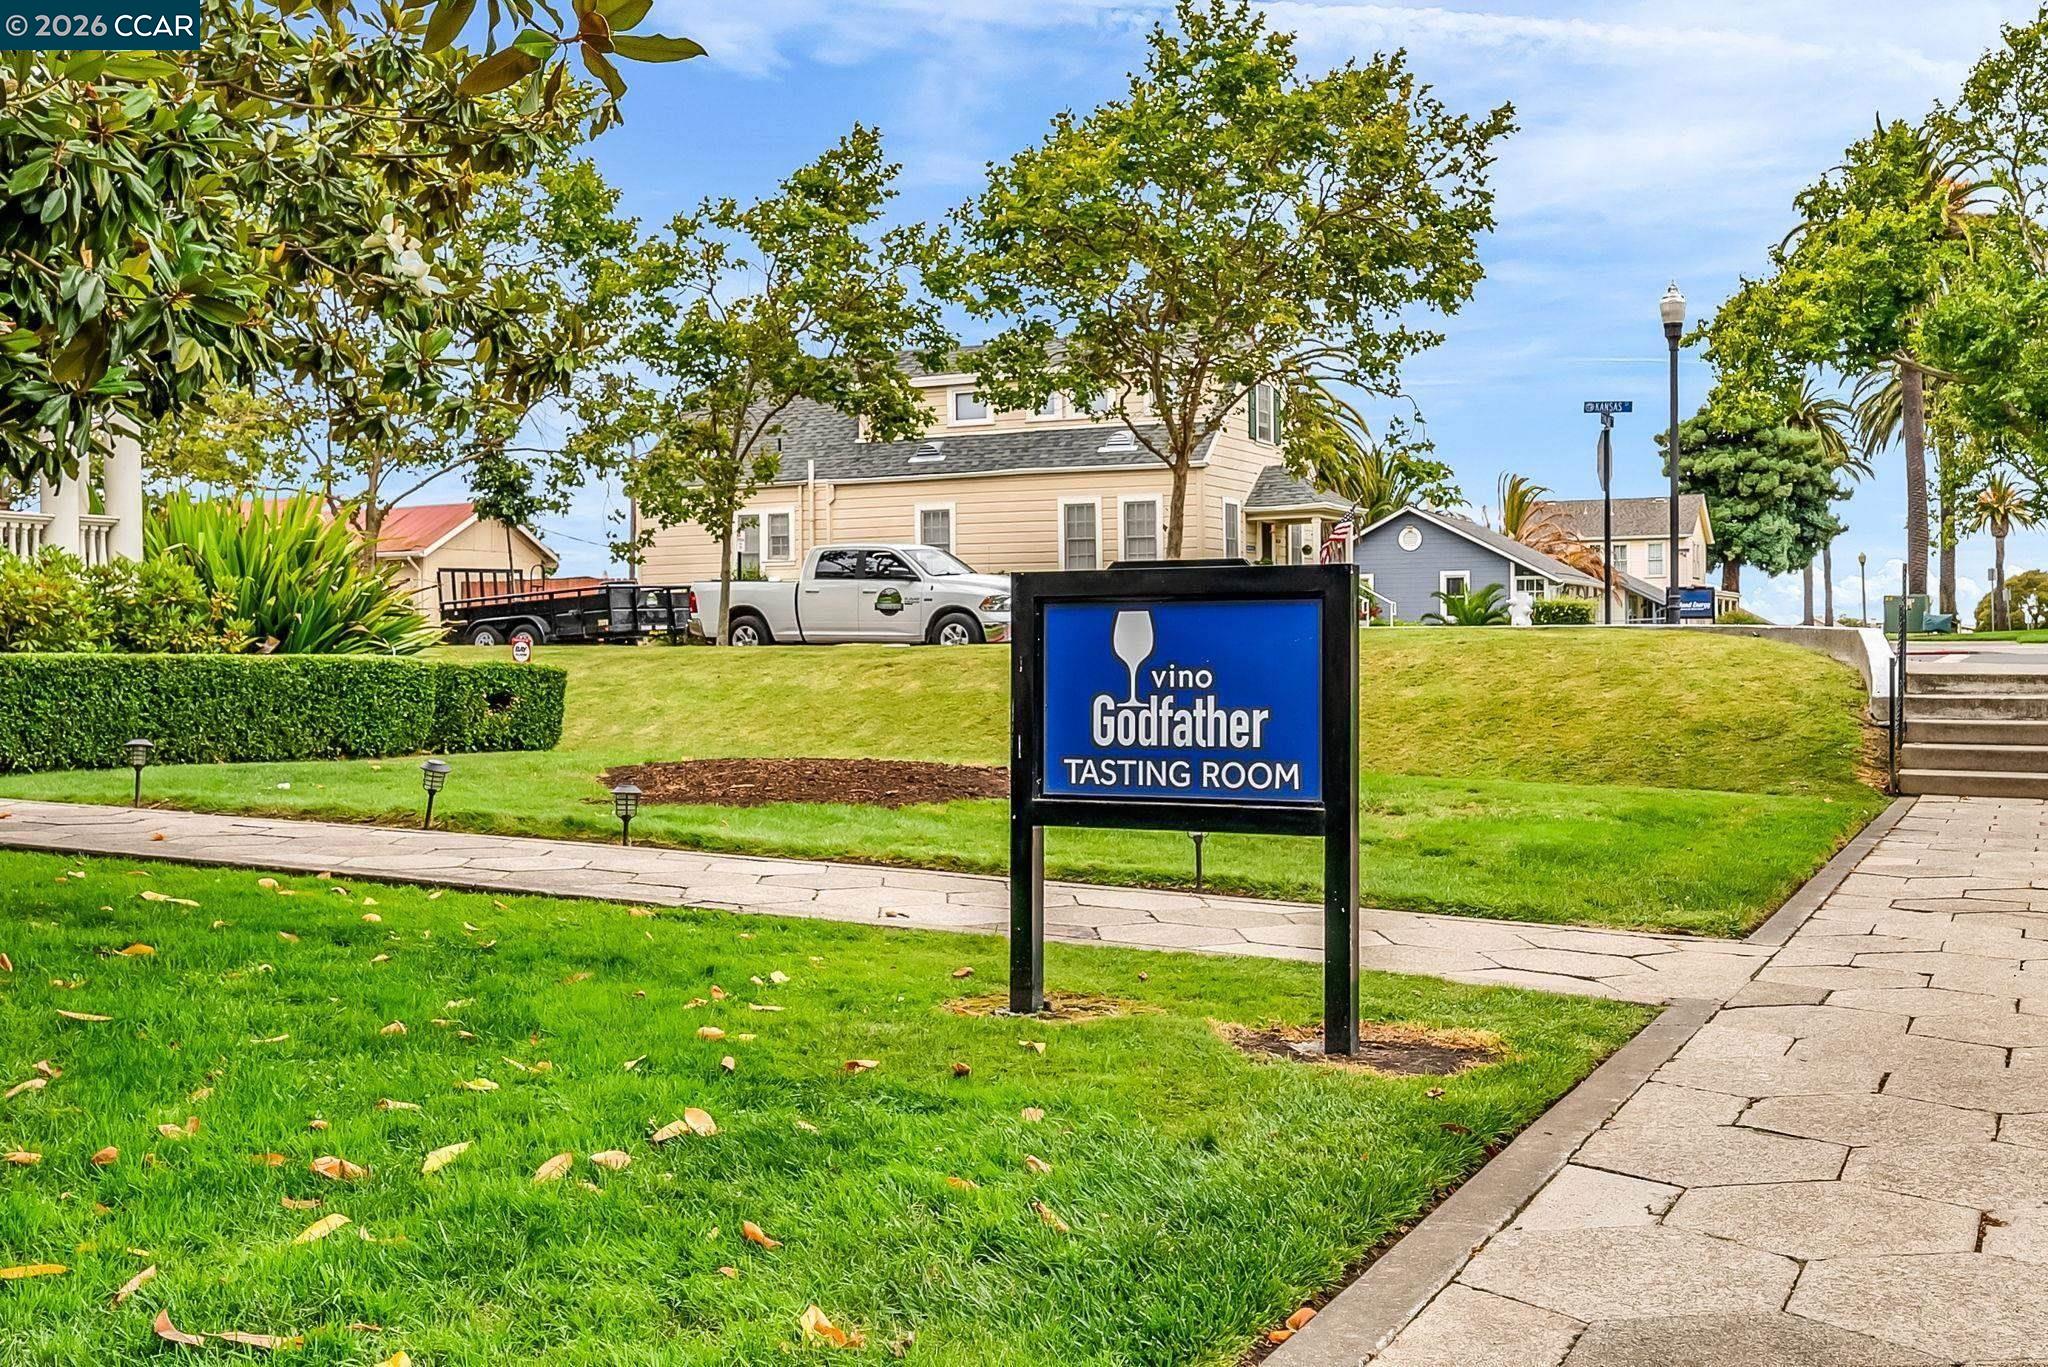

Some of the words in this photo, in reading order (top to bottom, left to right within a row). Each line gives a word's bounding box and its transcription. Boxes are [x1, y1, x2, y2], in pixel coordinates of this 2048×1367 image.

[1595, 402, 1623, 412] KANSAS
[1152, 664, 1213, 688] vino
[1092, 694, 1269, 748] Godfather
[1063, 758, 1191, 788] TASTING
[1202, 761, 1300, 790] ROOM
